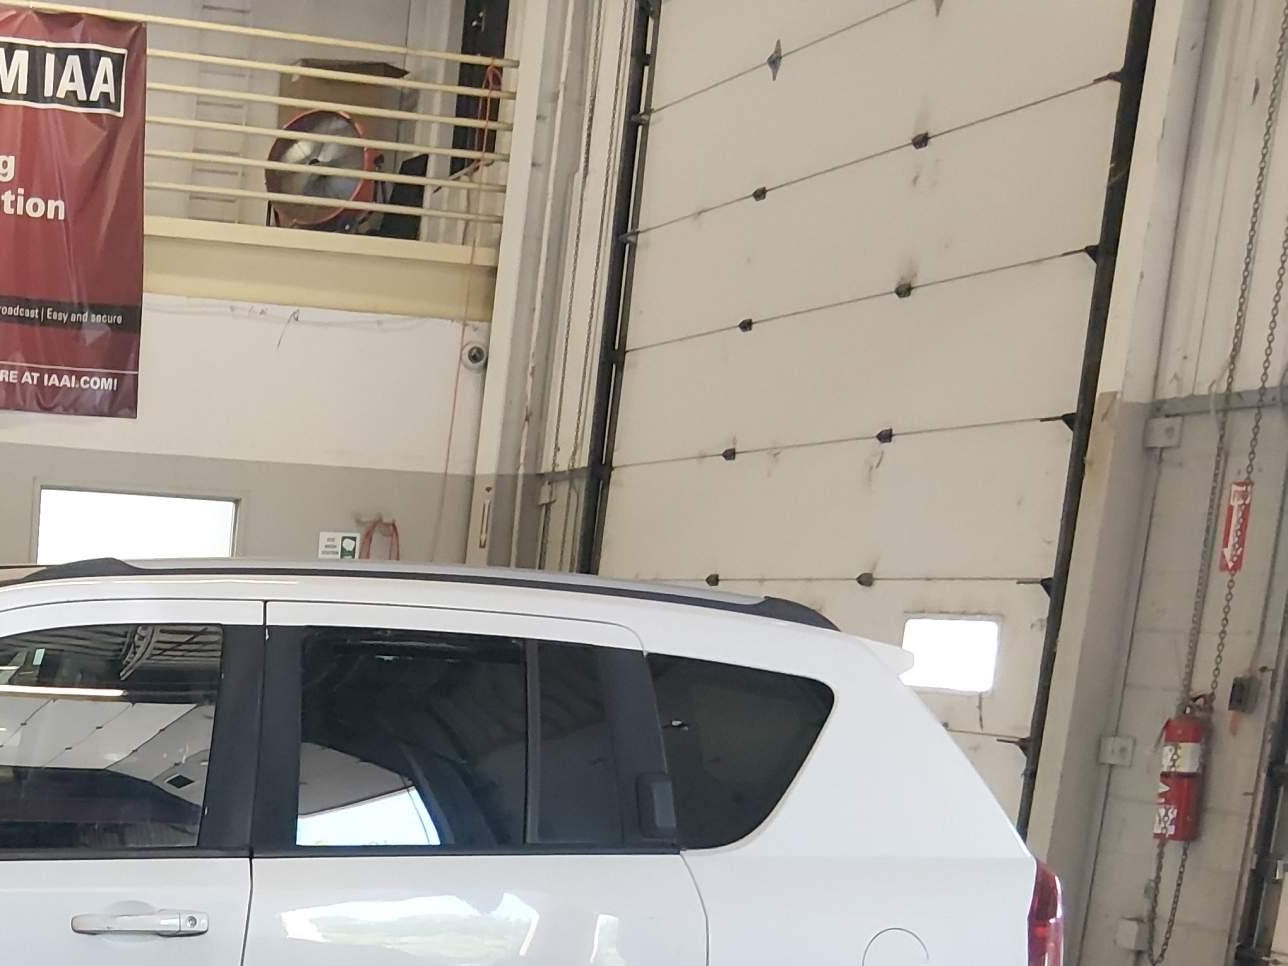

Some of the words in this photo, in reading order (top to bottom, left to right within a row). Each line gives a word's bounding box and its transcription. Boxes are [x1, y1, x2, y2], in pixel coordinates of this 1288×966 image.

[44, 53, 116, 103] IAA
[47, 309, 68, 324] Easy
[70, 311, 88, 322] and
[90, 314, 123, 325] secure
[21, 371, 40, 385] AT
[44, 374, 117, 391] IAAI.COM!
